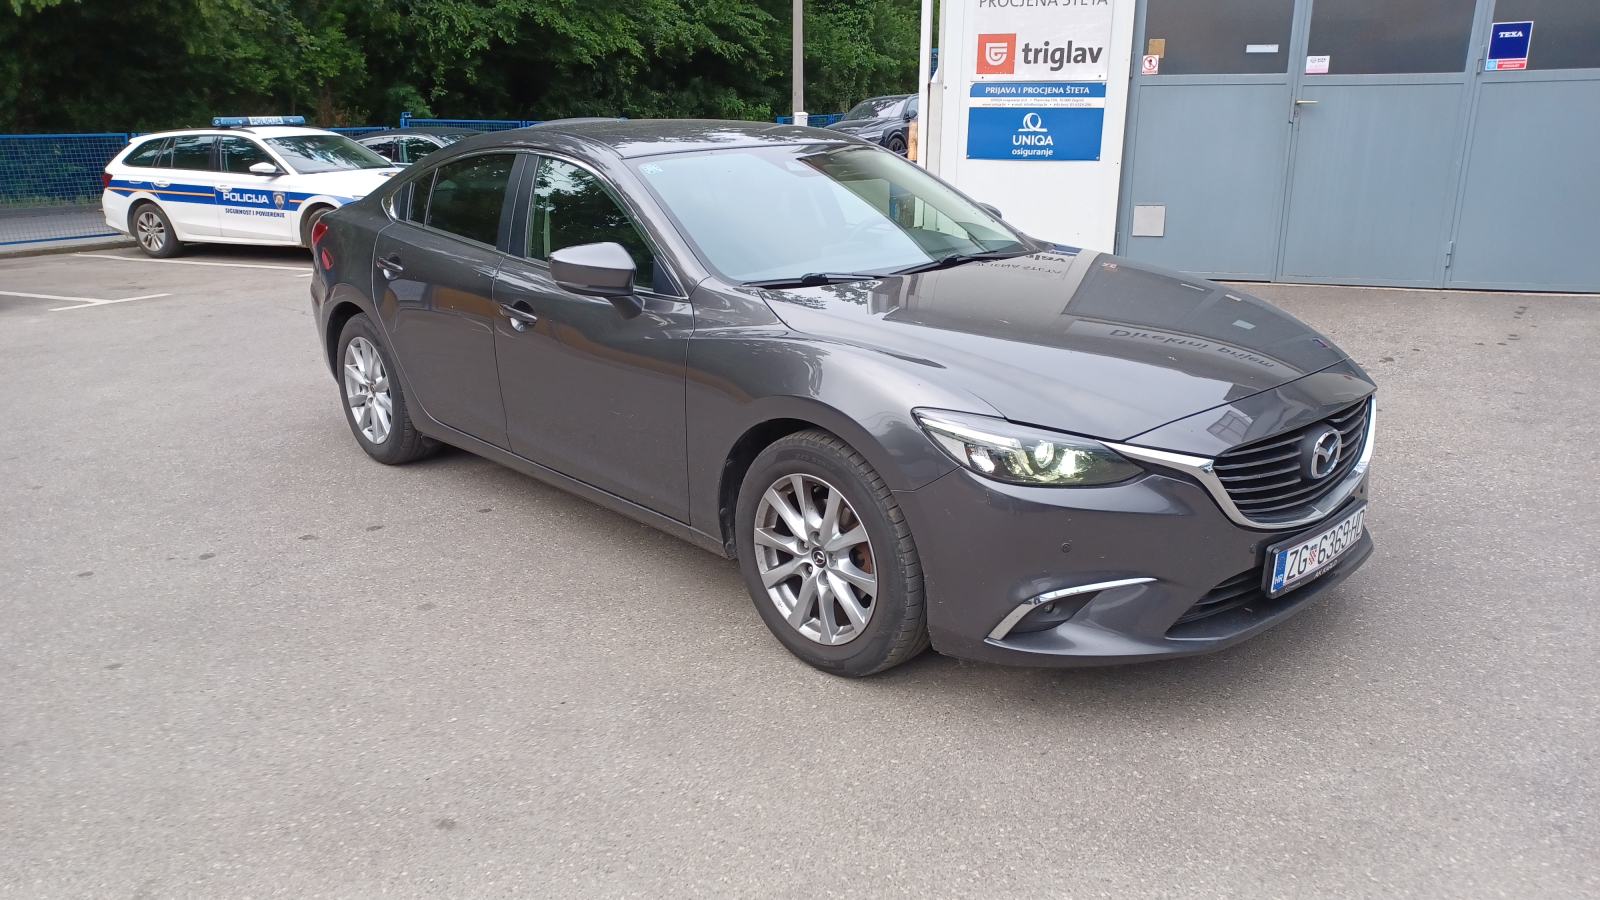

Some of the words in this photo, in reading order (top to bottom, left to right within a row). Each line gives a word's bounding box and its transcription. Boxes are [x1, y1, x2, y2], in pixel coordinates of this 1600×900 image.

[980, 0, 1058, 8] PROCJENA
[1022, 40, 1103, 71] triglav
[985, 87, 1016, 95] PRIJAVA
[1023, 87, 1063, 95] PROCJENA
[1065, 85, 1090, 94] ŠTETA
[1012, 135, 1054, 146] UNIQA
[1011, 147, 1054, 157] osiguranje
[222, 192, 270, 204] POLICIJA
[1286, 544, 1309, 579] ZG
